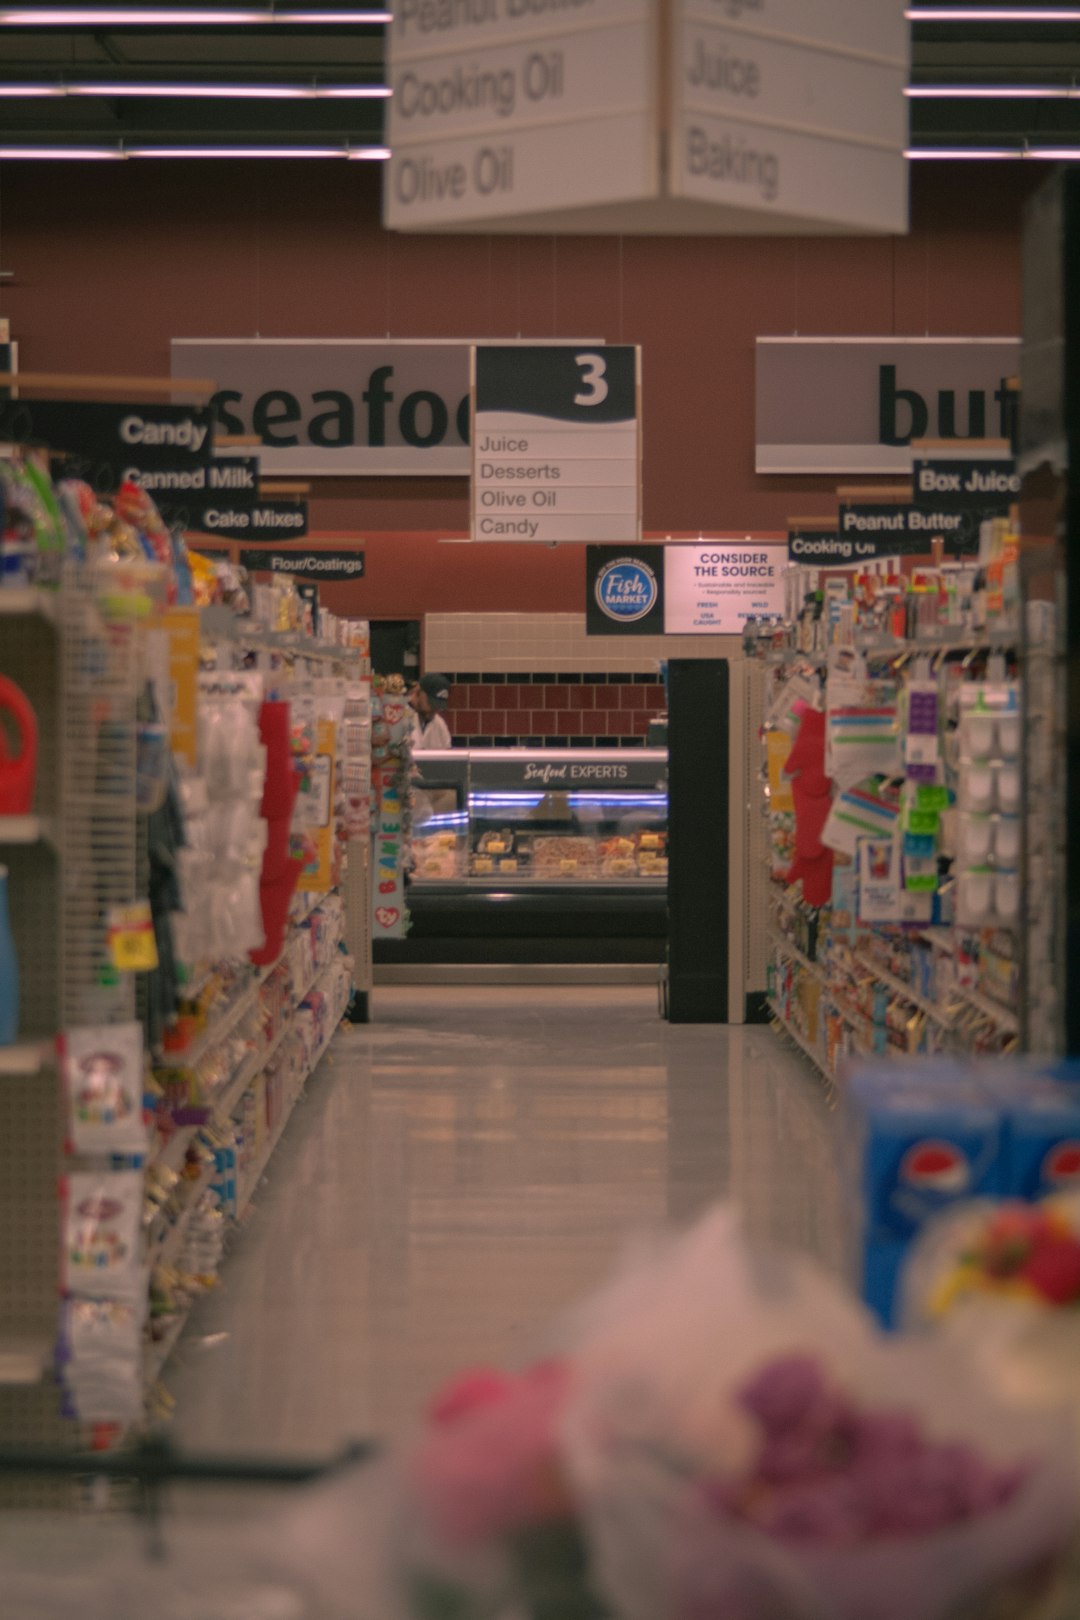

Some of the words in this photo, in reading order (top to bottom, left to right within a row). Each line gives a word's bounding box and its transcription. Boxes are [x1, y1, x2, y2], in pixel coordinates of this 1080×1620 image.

[687, 38, 762, 98] Juice
[400, 58, 515, 120] Cooking
[522, 51, 565, 101] Oil
[686, 127, 779, 200] Baking
[398, 153, 467, 204] Olive
[472, 147, 515, 195] Oil
[574, 354, 609, 406] 3
[208, 365, 470, 448] seafo
[120, 415, 208, 451] Candy
[479, 436, 529, 452] Juice
[122, 466, 205, 490] Canned
[210, 467, 254, 489] Milk
[480, 463, 561, 479] Desserts
[919, 470, 961, 492] Box
[965, 472, 1021, 492] Juice
[481, 491, 527, 507] Olive
[532, 491, 556, 507] Oil
[204, 510, 249, 528] Cake
[253, 510, 304, 528] Mixes
[480, 518, 539, 537] Candy
[844, 513, 904, 531] Peanut
[908, 512, 962, 530] Butter
[792, 539, 852, 557] Cooking
[271, 557, 362, 573] Flour/Coatings
[700, 553, 768, 564] CONSIDER
[694, 566, 718, 577] THE
[722, 566, 775, 577] SOURCE
[607, 573, 647, 595] Fish
[605, 595, 649, 604] MARKET
[524, 763, 567, 783] Seafood
[571, 765, 628, 778] EXPERTS
[377, 822, 401, 895] BEANIE
